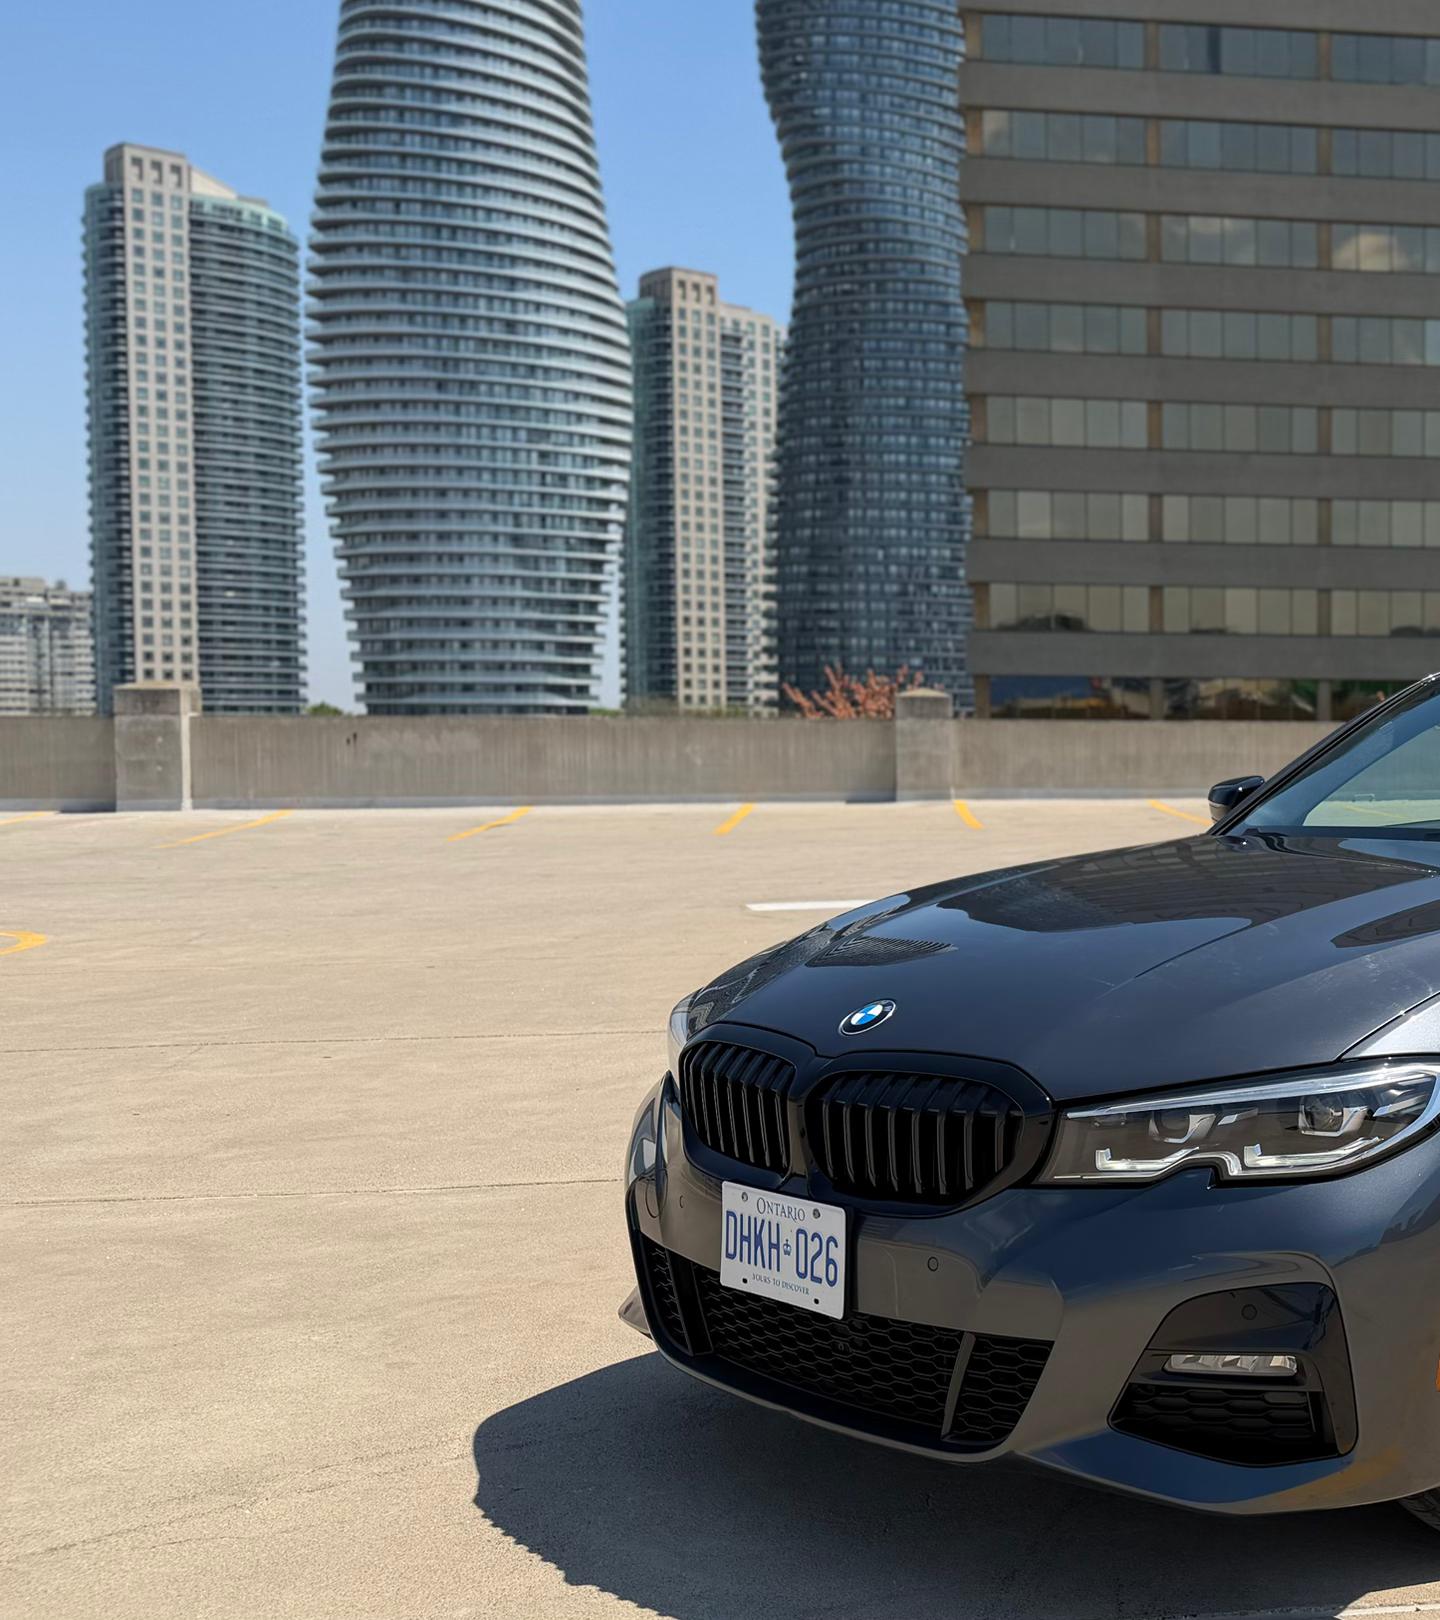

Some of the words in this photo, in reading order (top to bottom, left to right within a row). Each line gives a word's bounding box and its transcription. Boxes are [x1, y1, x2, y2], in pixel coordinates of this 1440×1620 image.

[756, 1197, 805, 1222] ONTARIO
[725, 1210, 781, 1272] DHKH
[795, 1228, 839, 1288] 026
